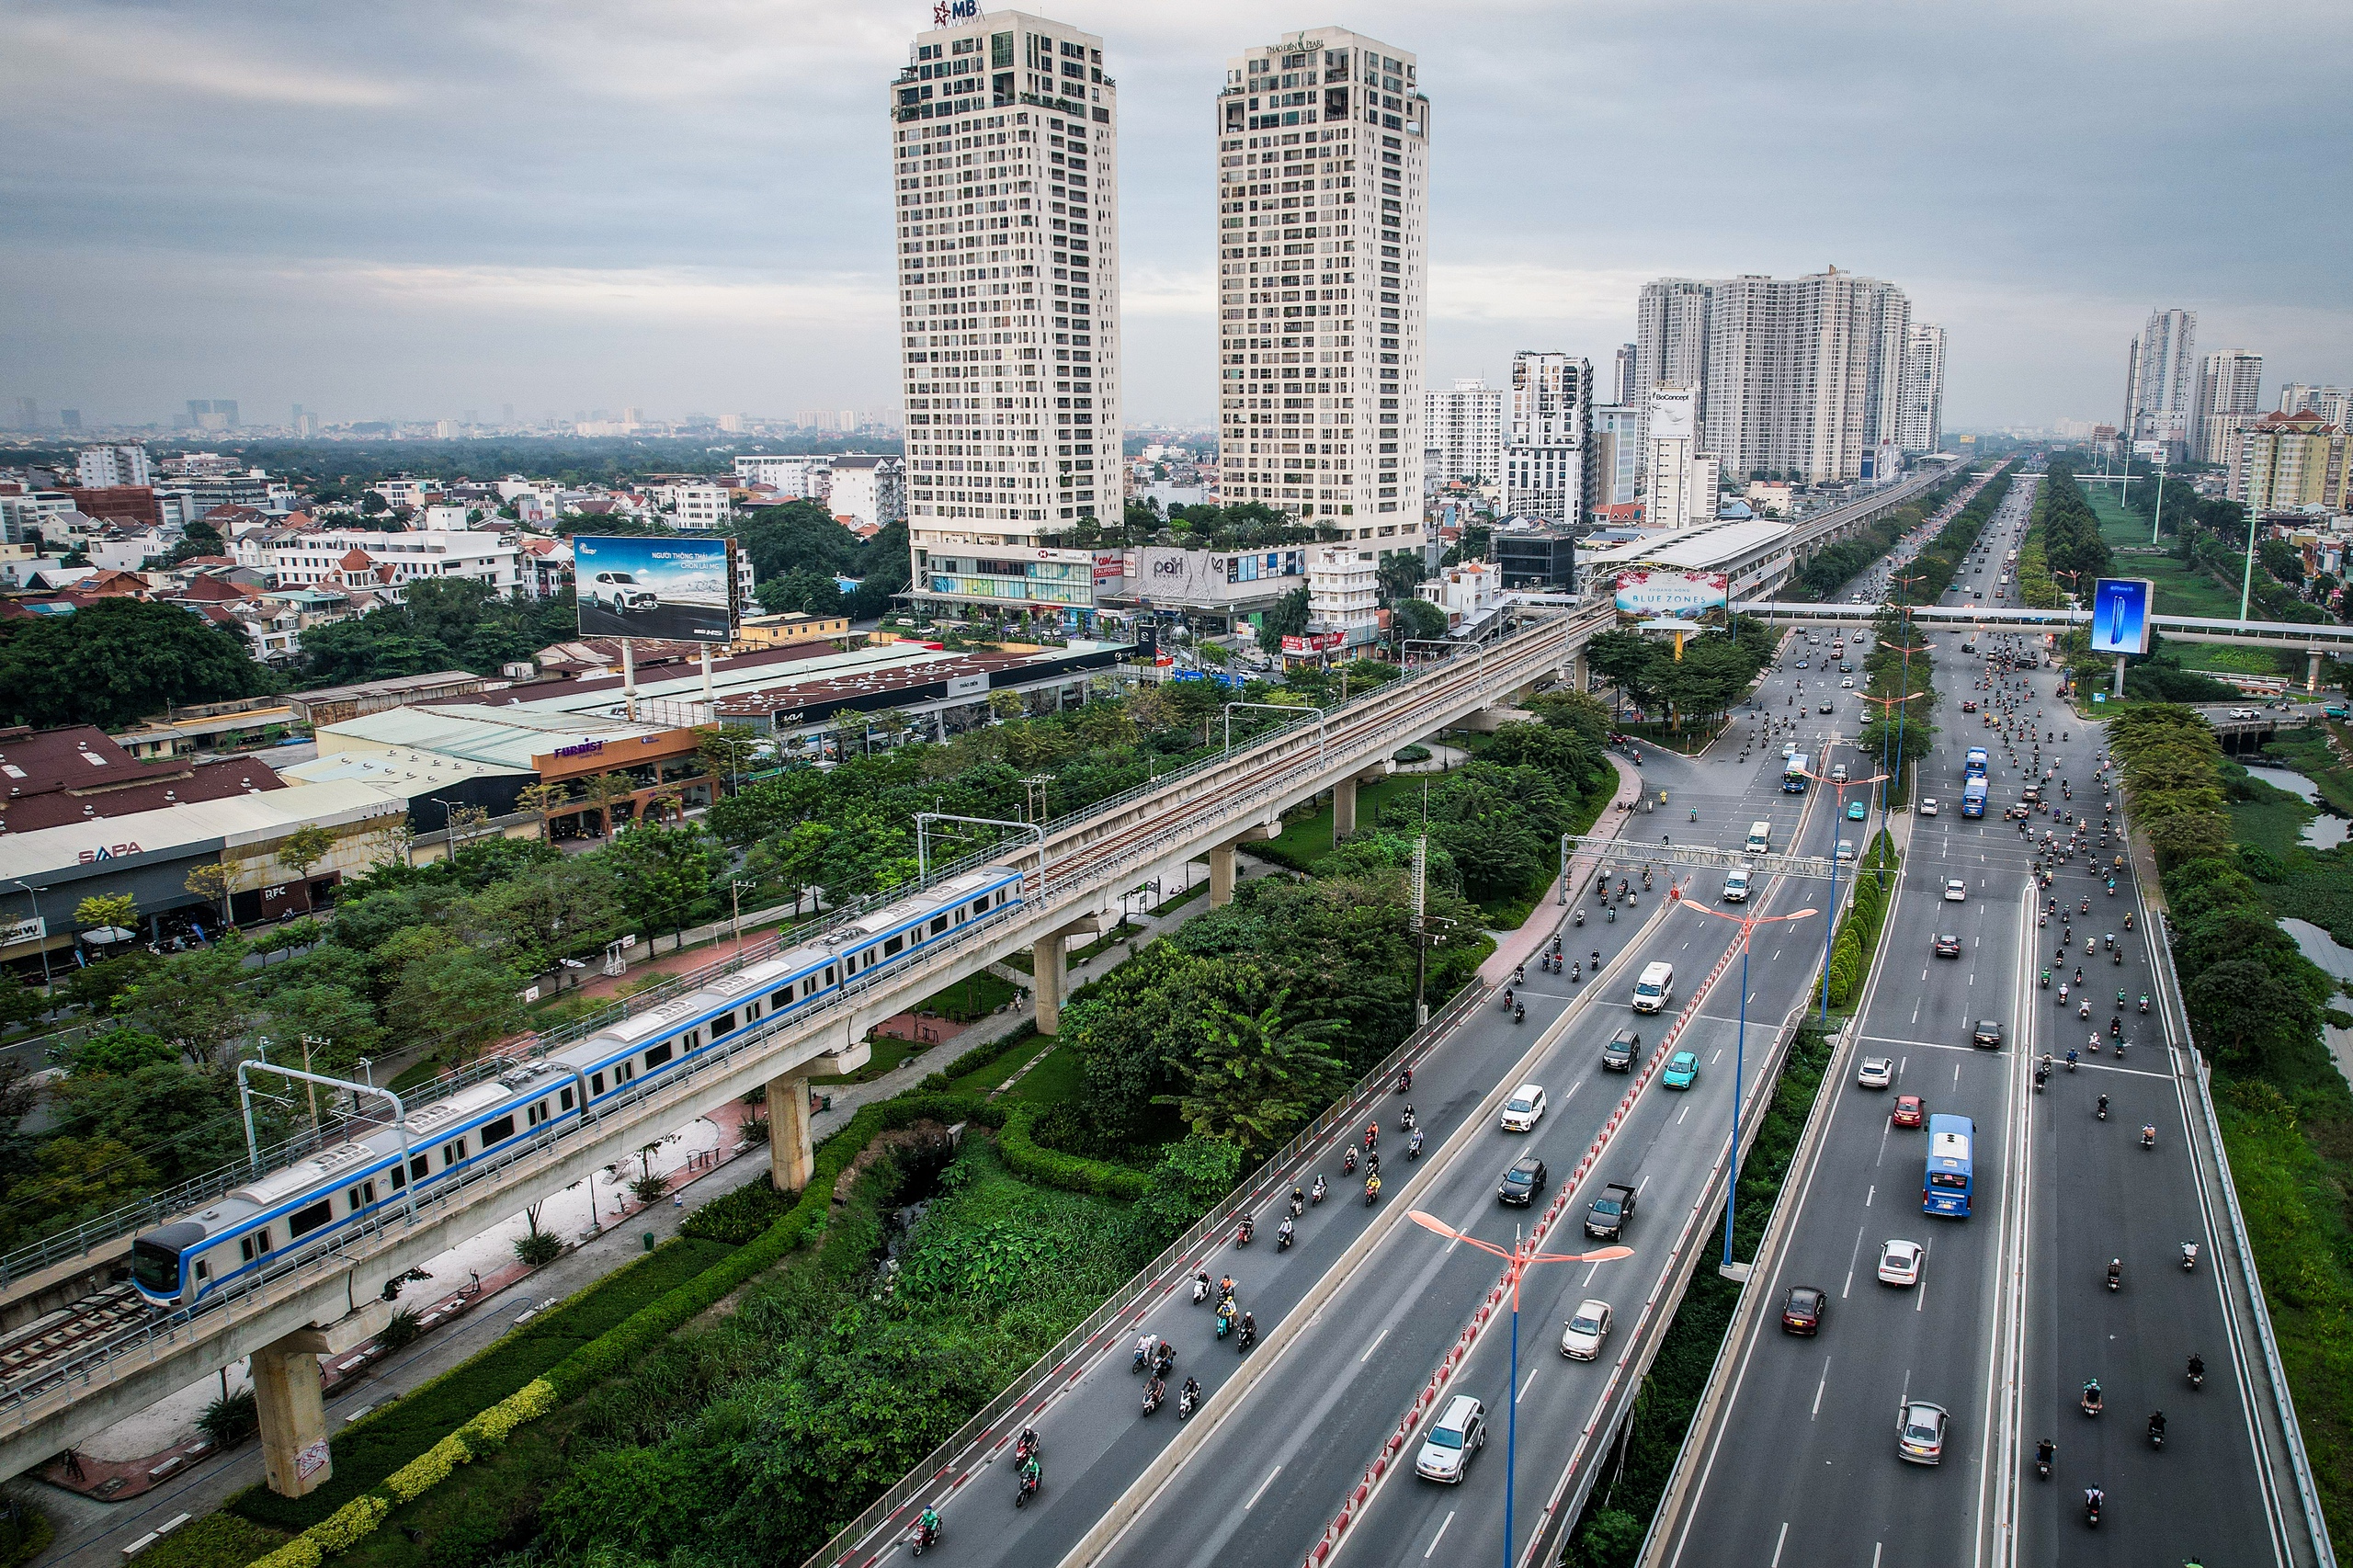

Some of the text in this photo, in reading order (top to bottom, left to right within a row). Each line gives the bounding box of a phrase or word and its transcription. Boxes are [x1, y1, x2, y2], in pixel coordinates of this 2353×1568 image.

[952, 0, 976, 19] MB
[1306, 40, 1324, 49] PEARL
[672, 551, 693, 560] THÔNG
[1095, 566, 1121, 574] CALIFORNIA
[1632, 595, 1706, 604] BLUE ZONES
[79, 841, 144, 864] SAPA
[265, 886, 286, 901] RFC
